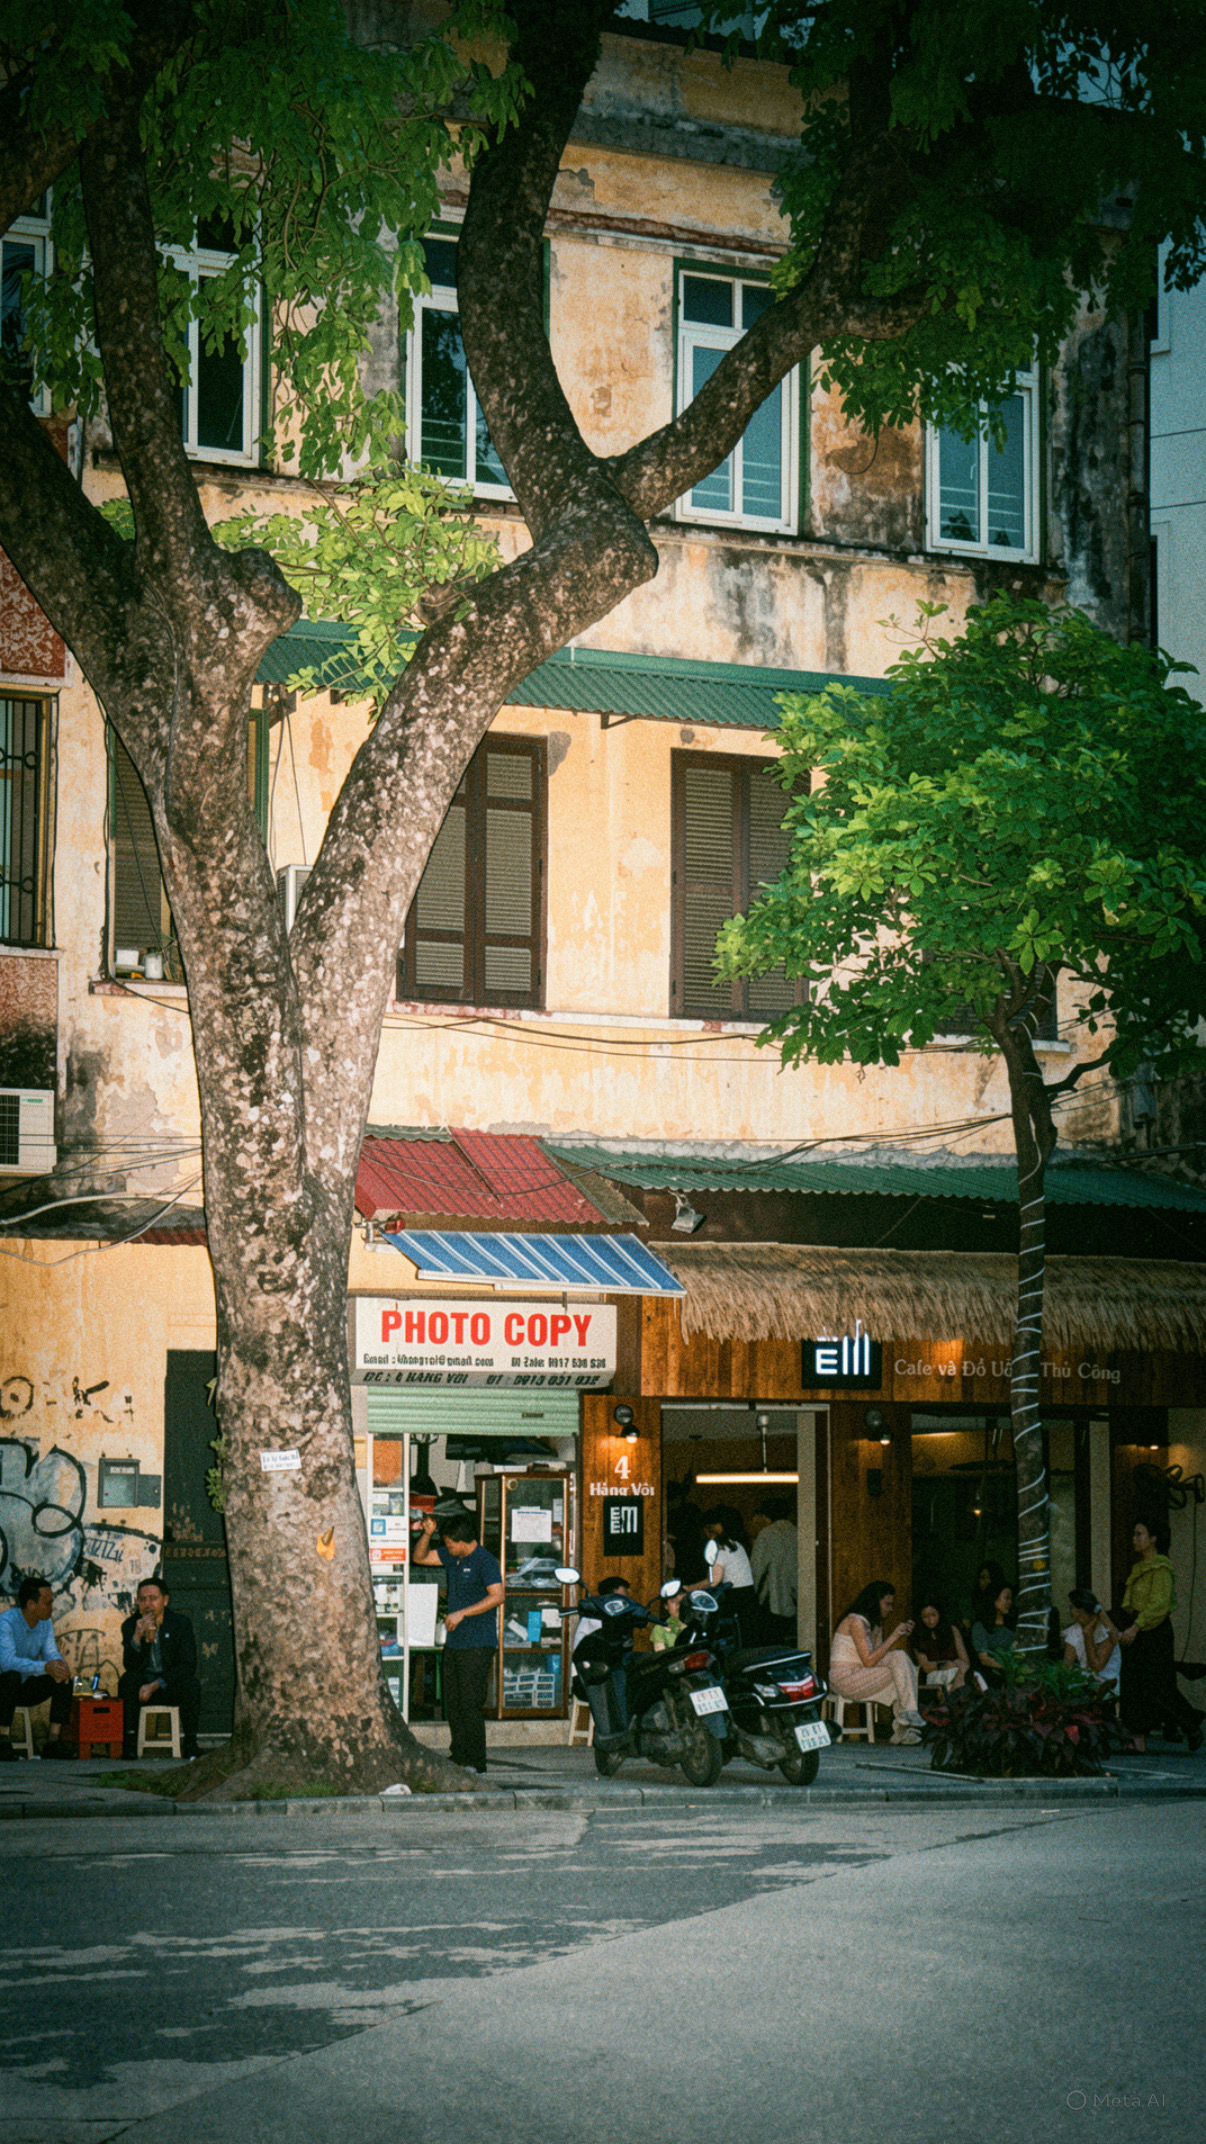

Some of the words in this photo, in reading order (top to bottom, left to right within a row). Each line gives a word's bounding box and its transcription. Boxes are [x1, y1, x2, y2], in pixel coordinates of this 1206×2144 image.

[381, 1310, 491, 1346] PHOTO
[504, 1312, 592, 1347] COPY
[894, 1359, 932, 1376] Cafe
[938, 1360, 957, 1377] và
[1077, 1362, 1121, 1384] Công
[614, 1455, 631, 1480] 4
